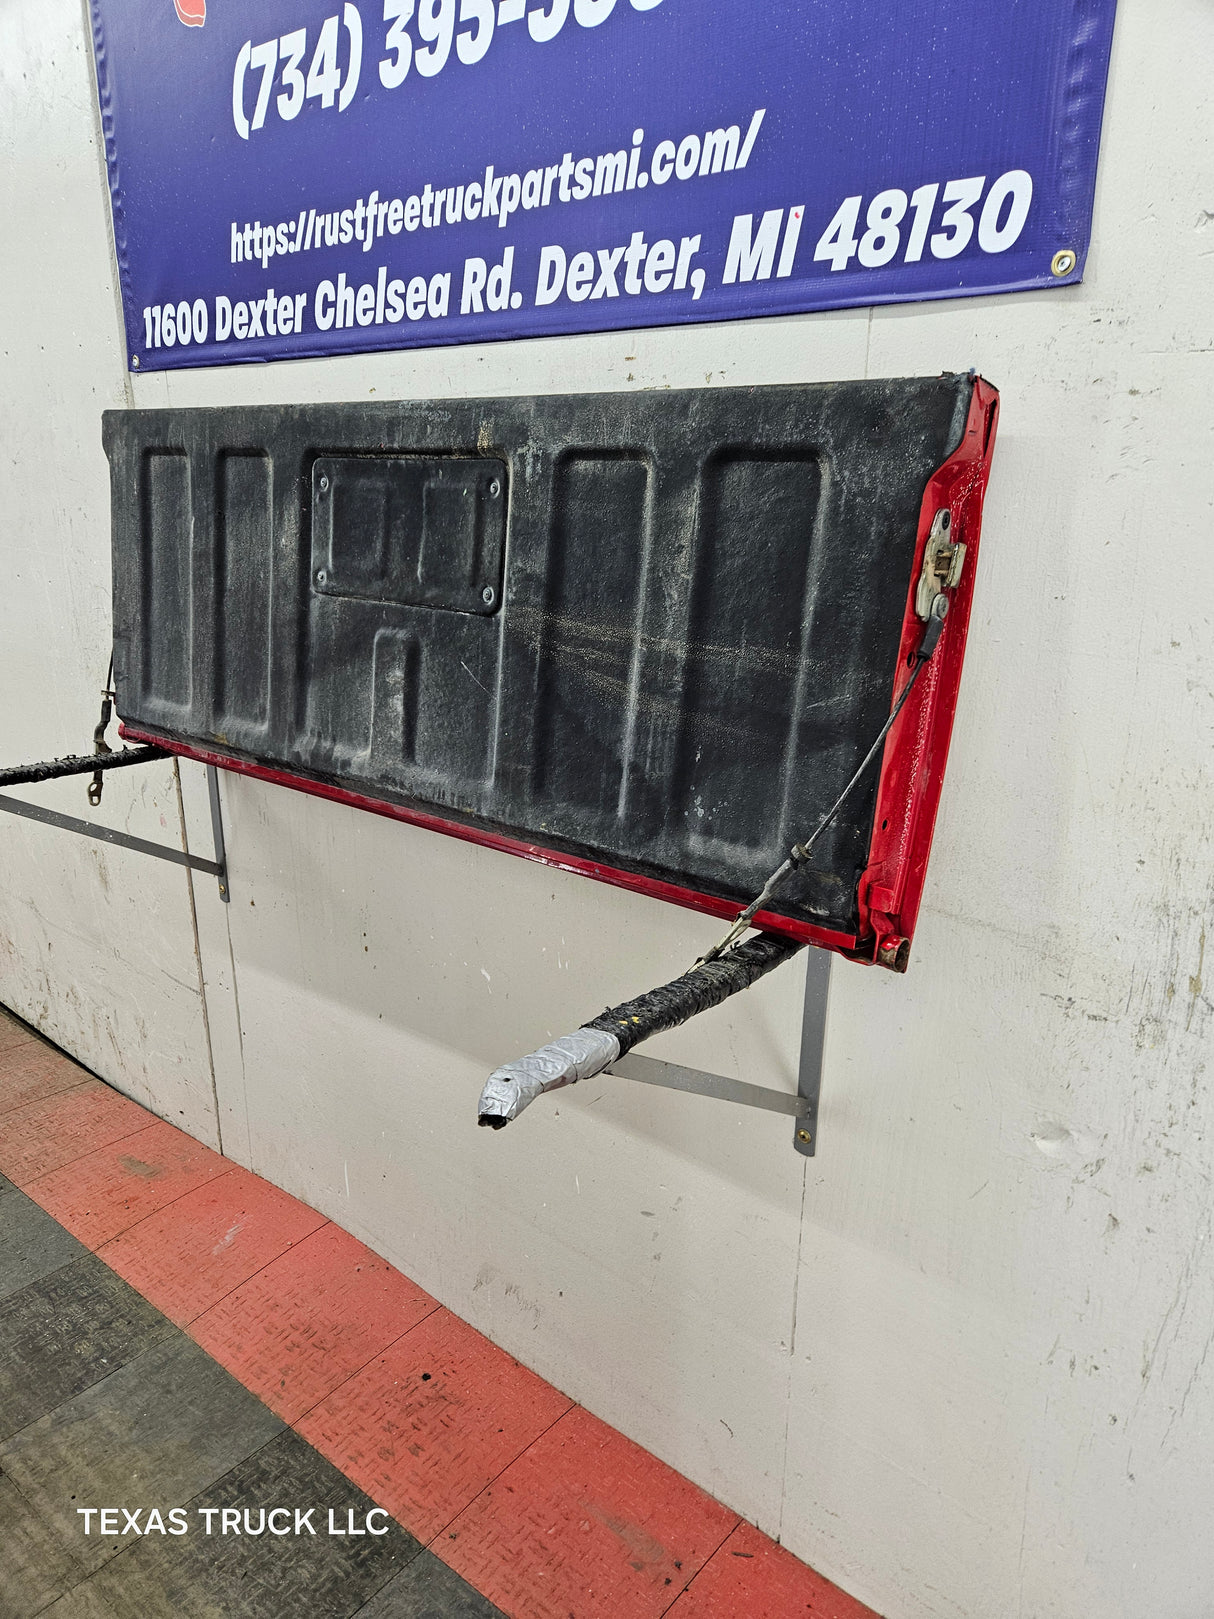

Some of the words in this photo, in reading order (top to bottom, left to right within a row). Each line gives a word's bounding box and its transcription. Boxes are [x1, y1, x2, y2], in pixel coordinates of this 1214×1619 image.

[232, 2, 363, 140] (734)
[143, 299, 209, 348] 11600
[215, 289, 306, 342] Dexter
[314, 266, 451, 331] Chelsea
[459, 246, 523, 315] Rd.
[534, 231, 706, 311] Dexter,
[721, 204, 806, 285] MI
[813, 169, 1033, 272] 48130
[230, 109, 767, 269] https://rustfreetruckpartsmi.com/
